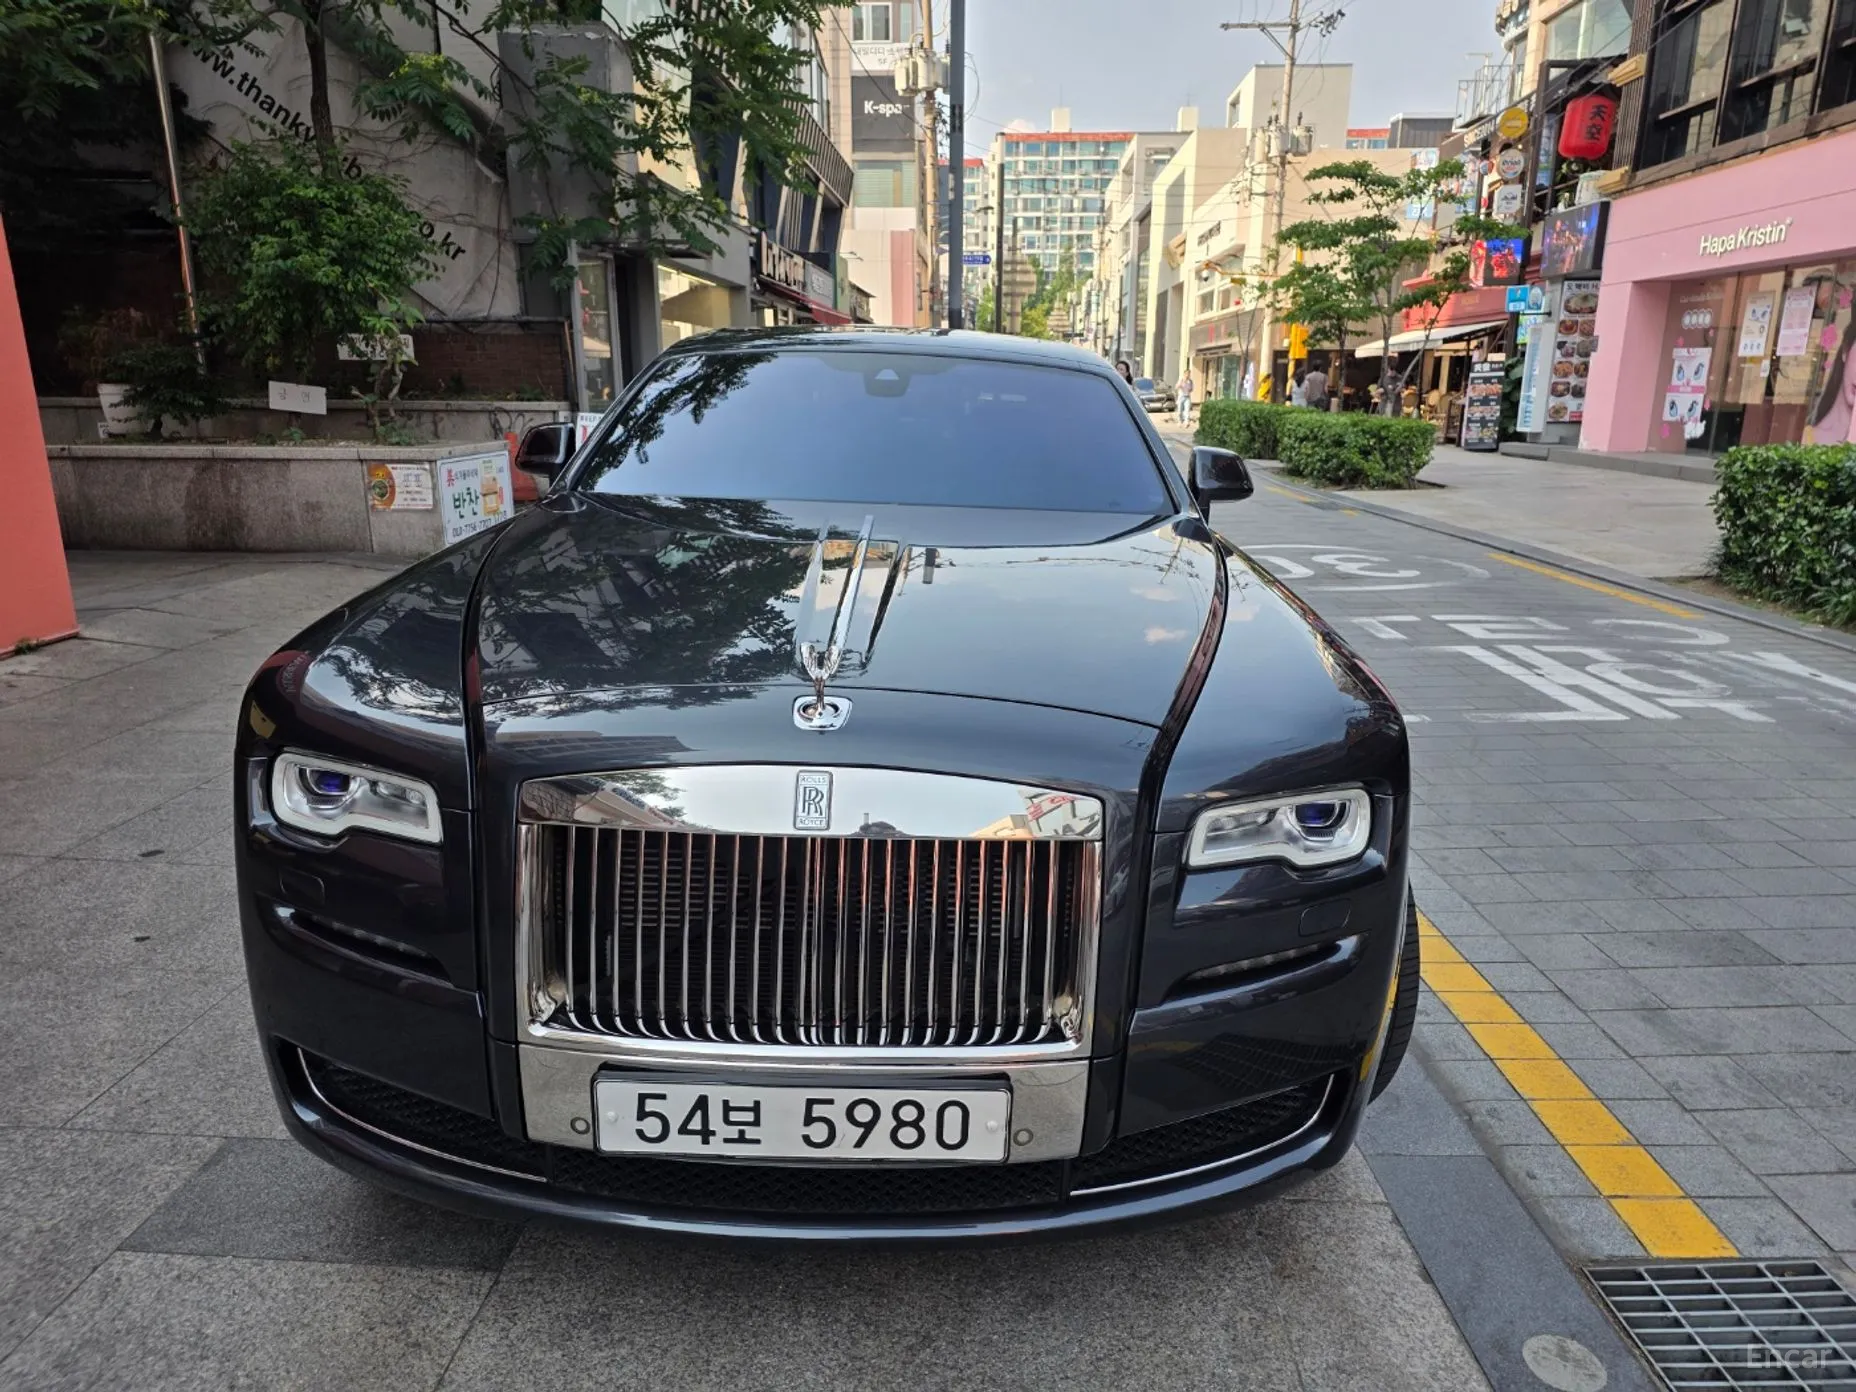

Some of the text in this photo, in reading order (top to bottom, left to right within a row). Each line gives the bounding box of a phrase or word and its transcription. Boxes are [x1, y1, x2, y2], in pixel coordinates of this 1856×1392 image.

[864, 100, 903, 117] K-spa
[1700, 234, 1736, 257] Hapa
[452, 487, 480, 519] 반찬
[802, 786, 825, 816] RR
[635, 1092, 971, 1151] 54보 5980
